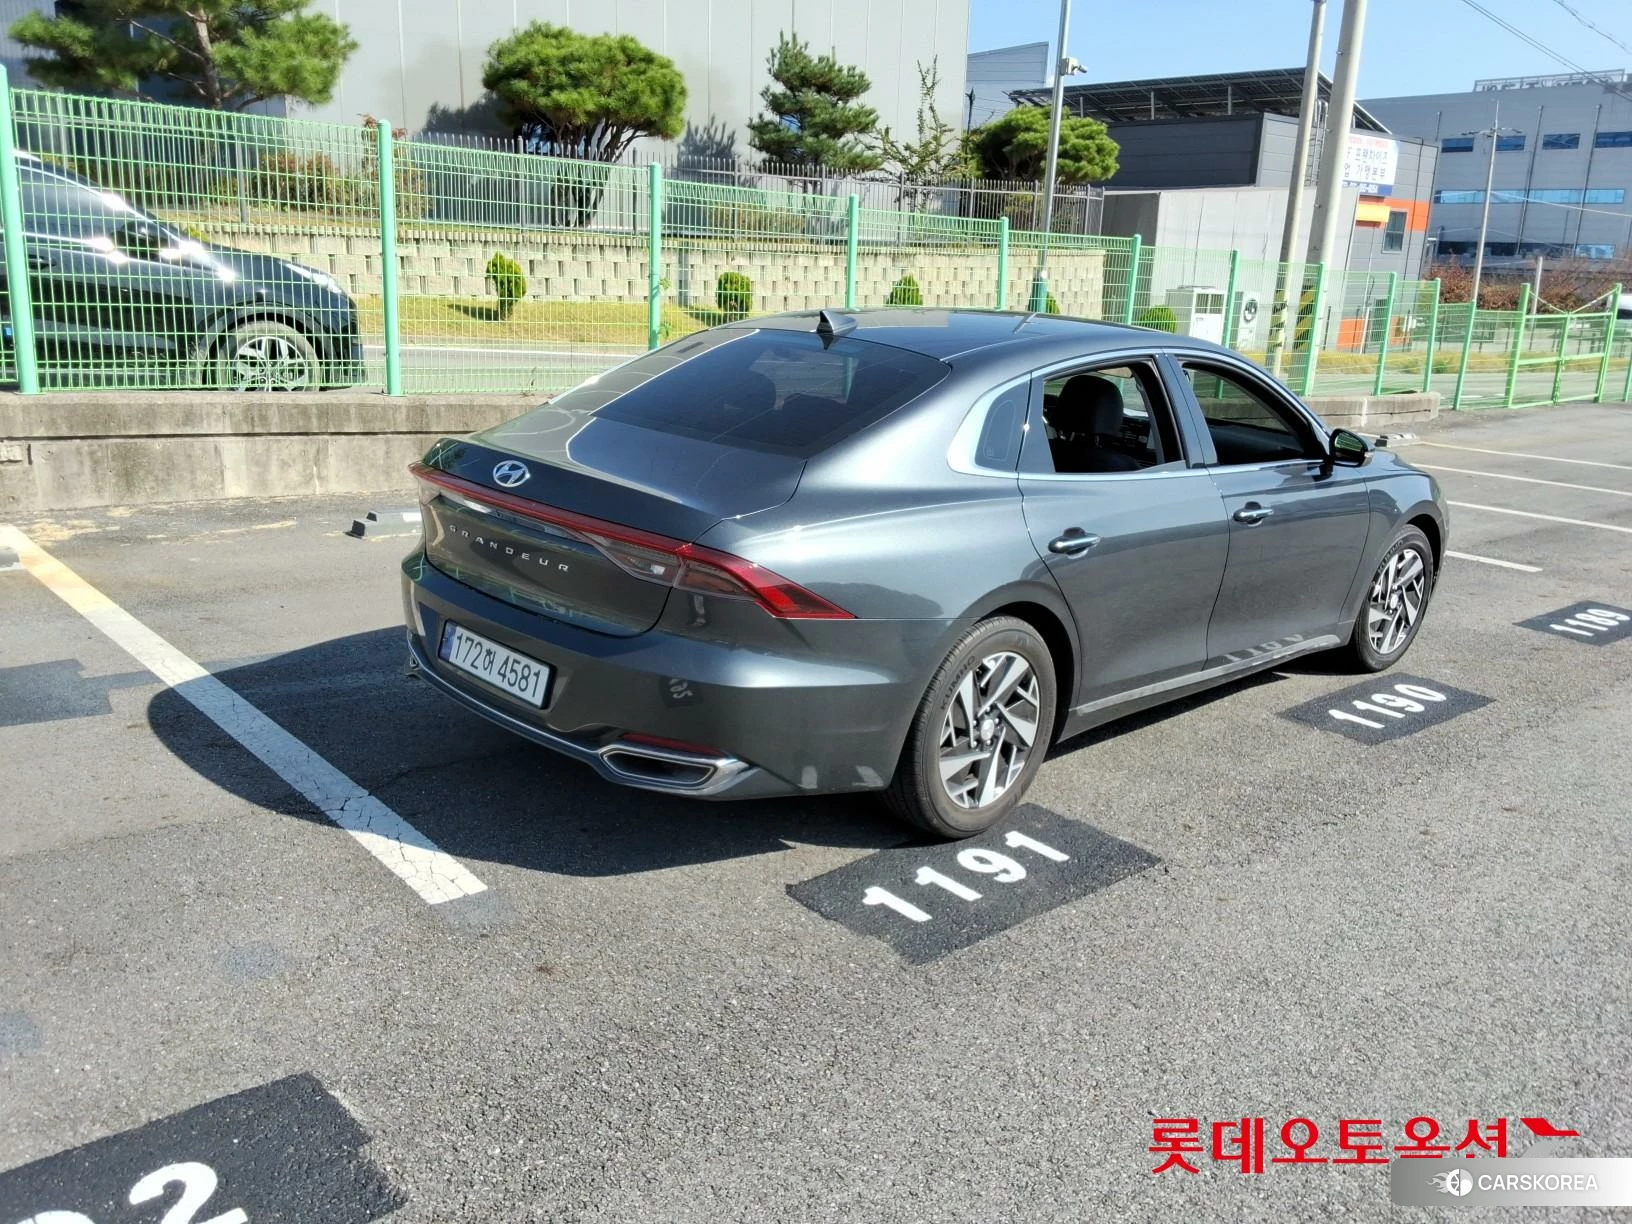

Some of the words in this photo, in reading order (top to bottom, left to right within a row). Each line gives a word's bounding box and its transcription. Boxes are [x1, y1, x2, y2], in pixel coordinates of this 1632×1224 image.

[449, 524, 570, 573] GRANDEUR
[1549, 608, 1631, 637] 1189
[455, 632, 497, 676] 172허
[497, 655, 541, 698] 4581
[940, 655, 977, 710] KUMHO
[1328, 683, 1448, 729] 1190
[862, 830, 1070, 923] 1191
[17, 1161, 249, 1224] 2
